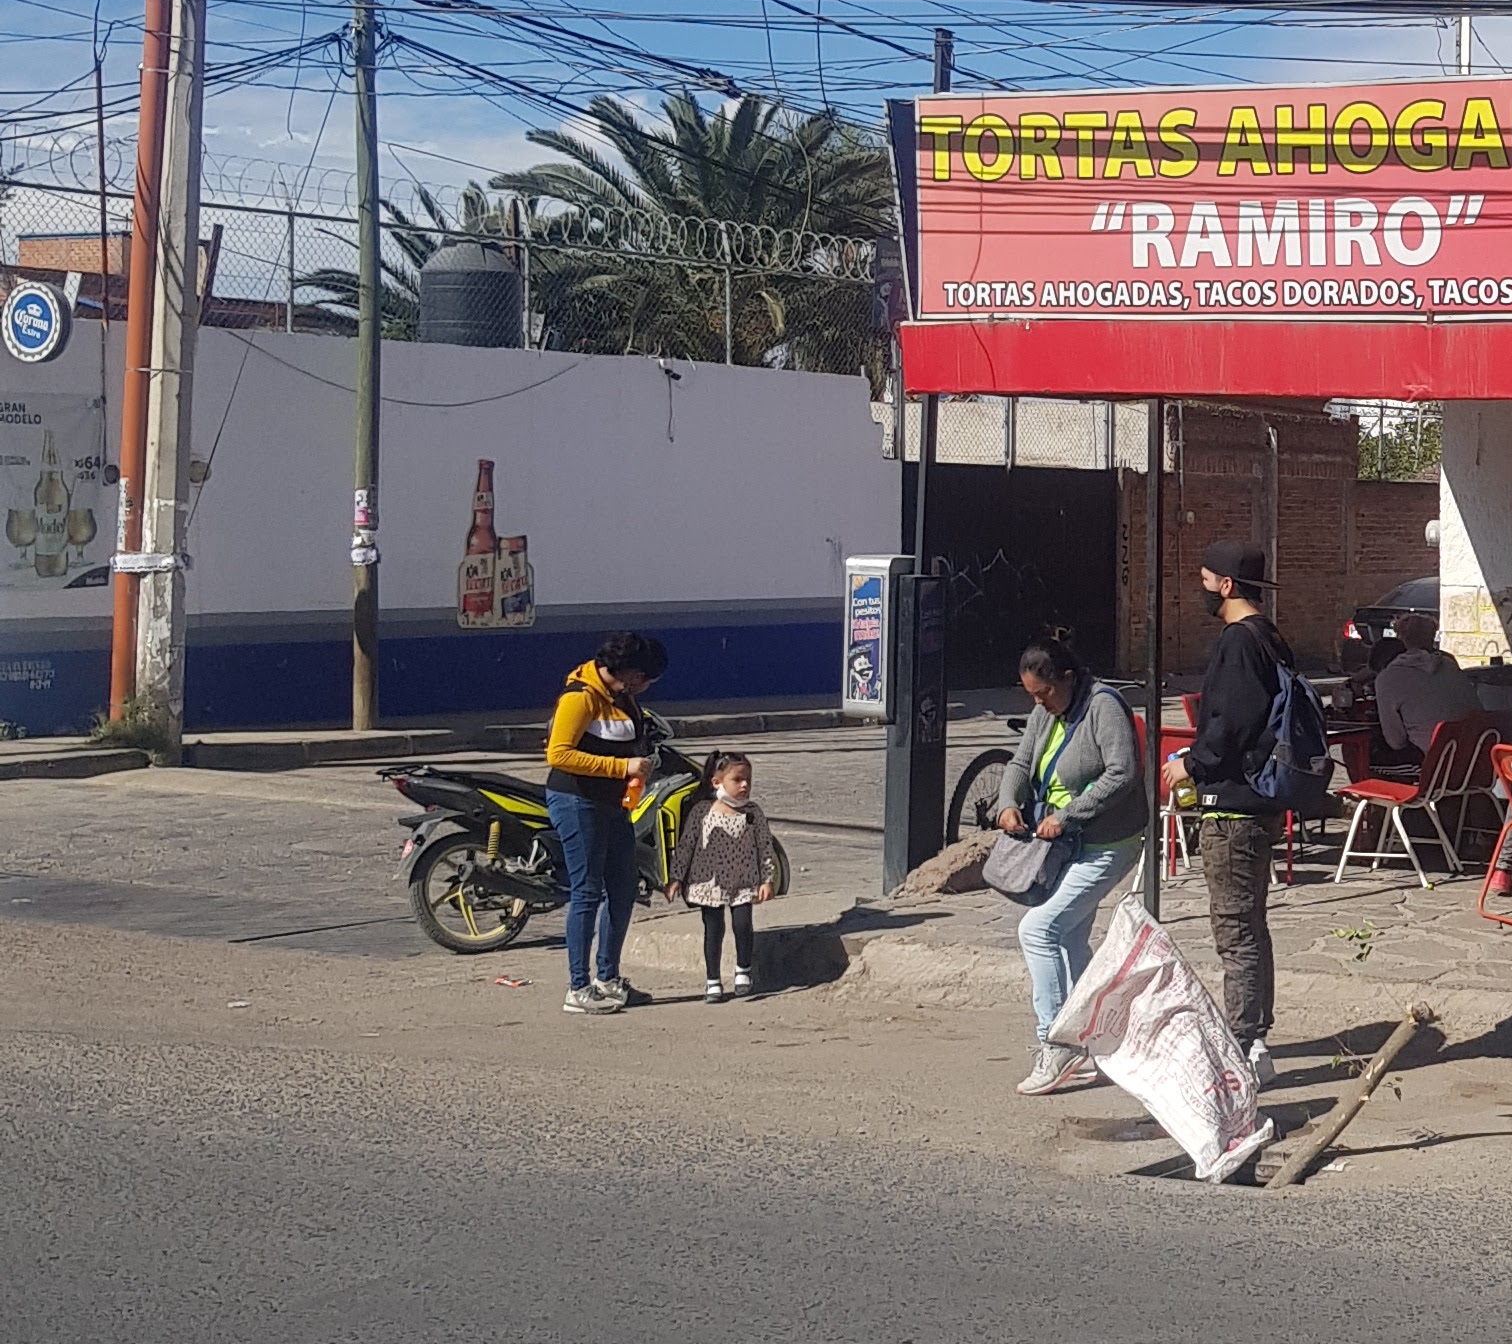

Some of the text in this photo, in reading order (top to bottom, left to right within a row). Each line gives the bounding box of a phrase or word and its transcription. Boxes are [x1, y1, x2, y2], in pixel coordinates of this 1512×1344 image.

[920, 107, 1200, 183] TORTAS
[943, 281, 1036, 309] TORTAS
[1039, 280, 1190, 311] AHOGADAS,
[1195, 279, 1278, 308] TACOS
[1282, 278, 1424, 310] DORADOS,
[14, 308, 49, 332] Corona
